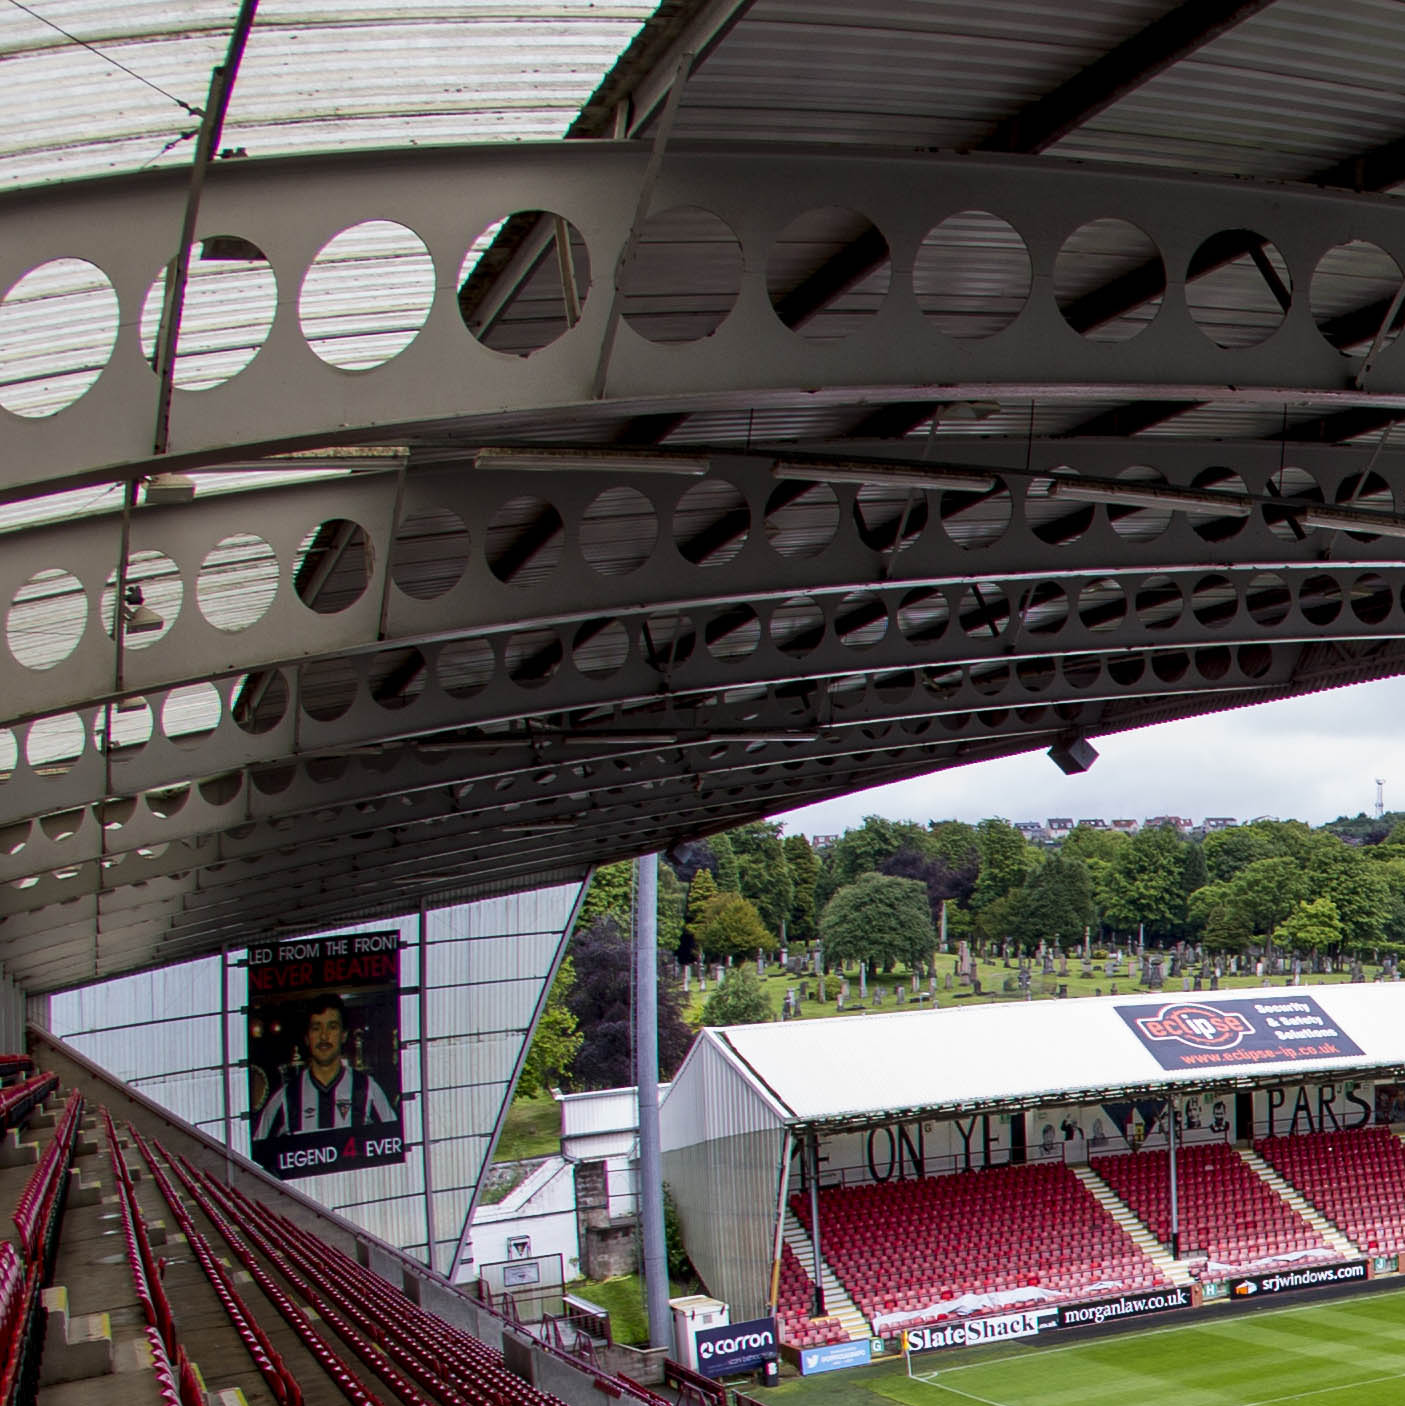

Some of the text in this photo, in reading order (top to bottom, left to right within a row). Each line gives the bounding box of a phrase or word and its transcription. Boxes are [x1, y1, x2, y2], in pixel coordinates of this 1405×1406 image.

[249, 935, 398, 965] LED FROM THE FRONT
[249, 954, 397, 990] NEVER BEATEN
[1145, 1013, 1245, 1040] eclipse
[1266, 1081, 1373, 1138] PARS
[280, 1136, 402, 1170] LEGEND 4 EVER
[1262, 1265, 1364, 1292] srjwindows.com
[1065, 1292, 1189, 1324] morganlaw.co.uk
[715, 1331, 774, 1354] carron
